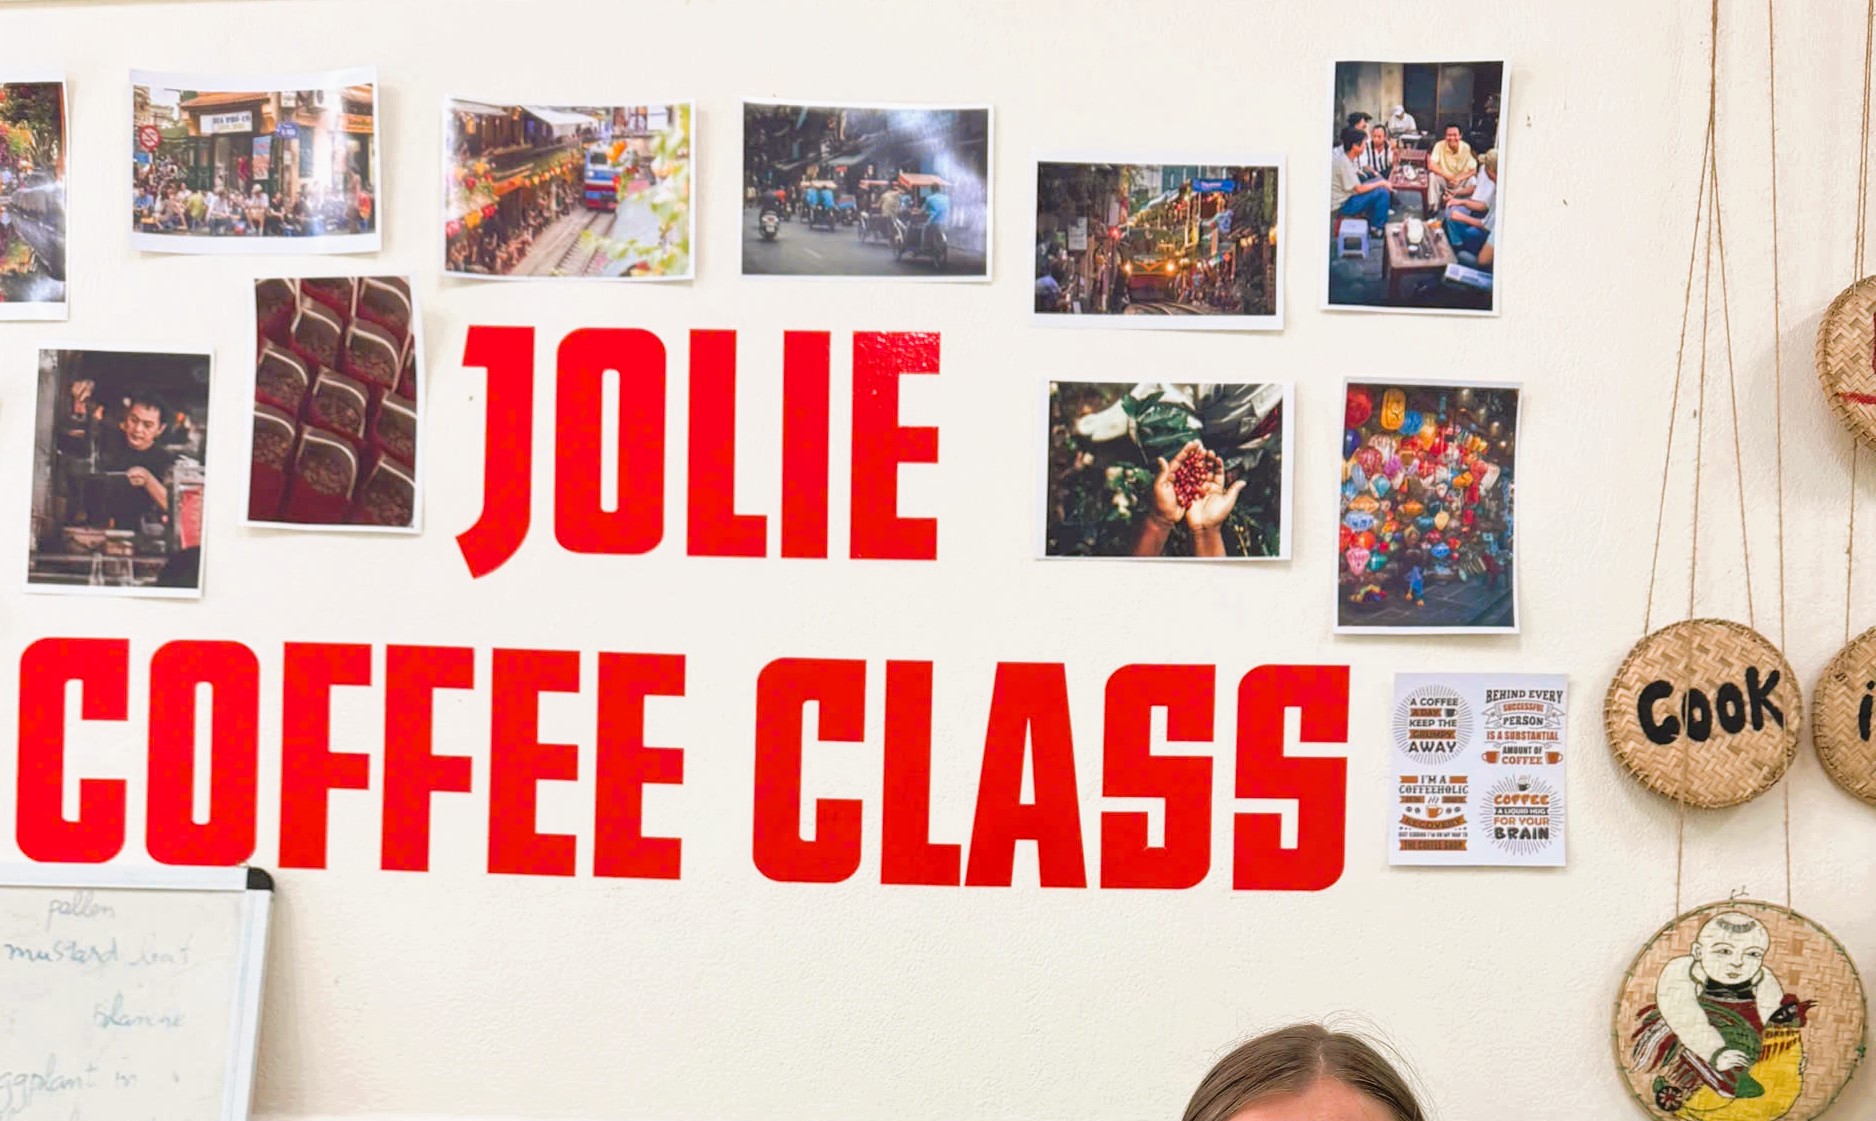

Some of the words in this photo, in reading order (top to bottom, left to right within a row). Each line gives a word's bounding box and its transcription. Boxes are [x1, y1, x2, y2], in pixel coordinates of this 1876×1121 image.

[456, 326, 942, 579] JOLIE
[1410, 697, 1417, 706] A
[1420, 697, 1459, 706] COFFEE
[1486, 689, 1526, 704] BEHIND
[1529, 689, 1563, 704] EVERY
[1637, 666, 1784, 745] COOK
[1409, 719, 1435, 727] KEEP
[1437, 719, 1457, 727] THE
[1503, 715, 1544, 726] PERSON
[1486, 731, 1495, 740] IS
[1497, 731, 1502, 740] A
[1504, 730, 1559, 741] SUBSTANTIAL
[1408, 740, 1457, 753] AWAY
[1502, 746, 1532, 755] AMOUNT
[1534, 746, 1543, 755] OF
[16, 637, 686, 880] COFFEE
[752, 657, 1350, 892] CLASS
[1501, 756, 1544, 765] COFFEE
[1420, 775, 1437, 784] I'M
[1439, 775, 1447, 784] A
[1398, 785, 1469, 794] COFFEEHOLIC
[1493, 793, 1550, 806] COFFEE
[1493, 817, 1516, 826] FOR
[1519, 817, 1550, 826] YOUR
[1494, 826, 1549, 840] BRAIN
